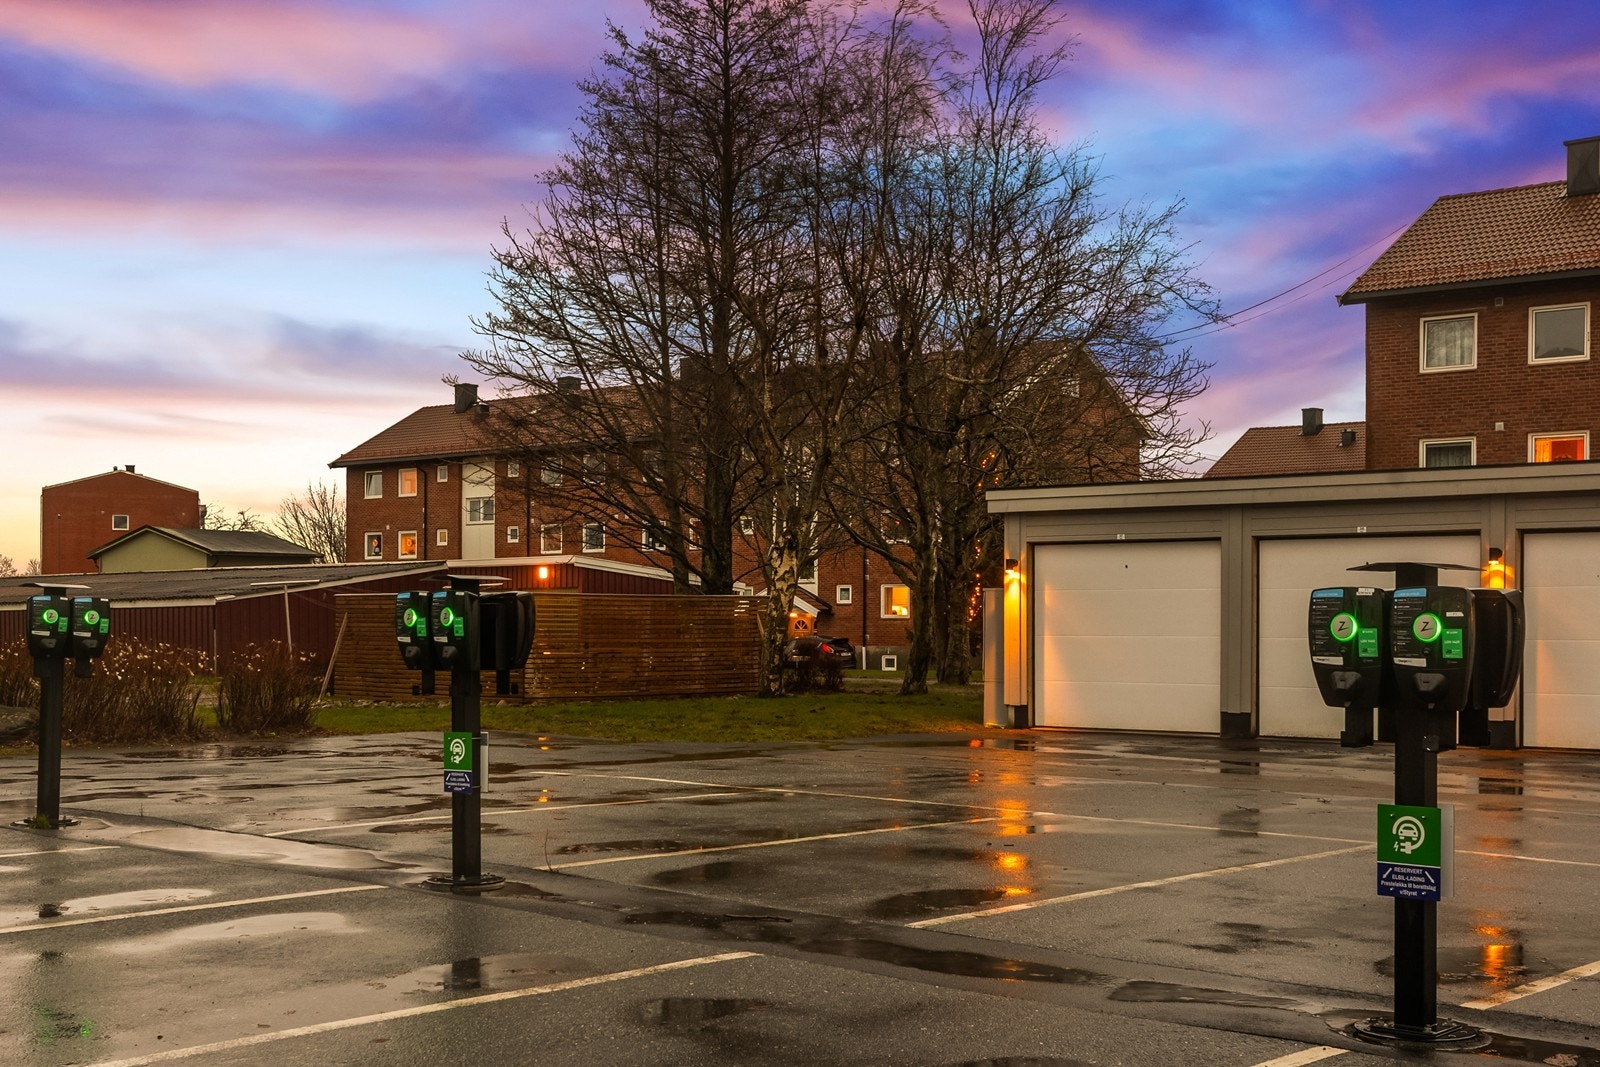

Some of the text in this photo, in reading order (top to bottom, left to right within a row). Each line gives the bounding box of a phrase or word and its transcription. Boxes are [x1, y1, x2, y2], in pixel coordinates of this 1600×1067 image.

[1338, 621, 1349, 631] Z
[1421, 621, 1433, 632] Z
[1392, 874, 1425, 882] ELBIL-LADING
